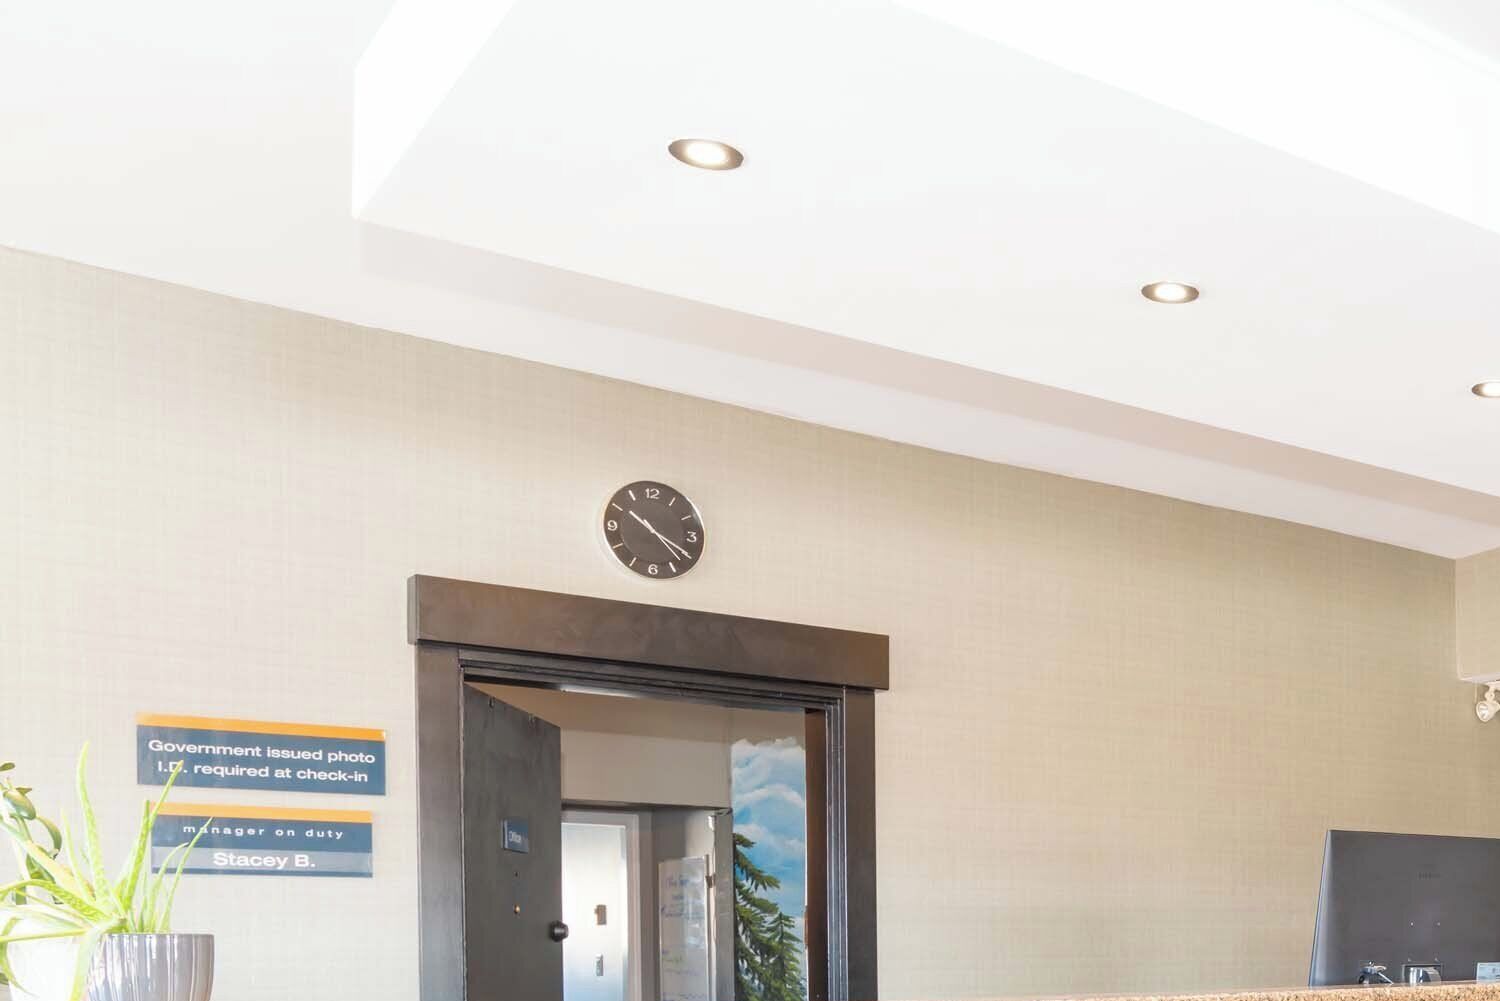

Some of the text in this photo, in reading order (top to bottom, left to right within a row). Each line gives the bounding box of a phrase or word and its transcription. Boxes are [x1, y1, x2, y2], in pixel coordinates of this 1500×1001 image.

[645, 488, 660, 499] 12
[607, 519, 618, 531] 9
[686, 531, 697, 543] 3
[648, 563, 658, 575] 6
[148, 739, 376, 764] Government issued photo
[157, 760, 368, 783] I.D. required at check-in
[275, 829, 295, 837] on
[305, 829, 343, 840] duty
[213, 852, 316, 870] Stacey B.
